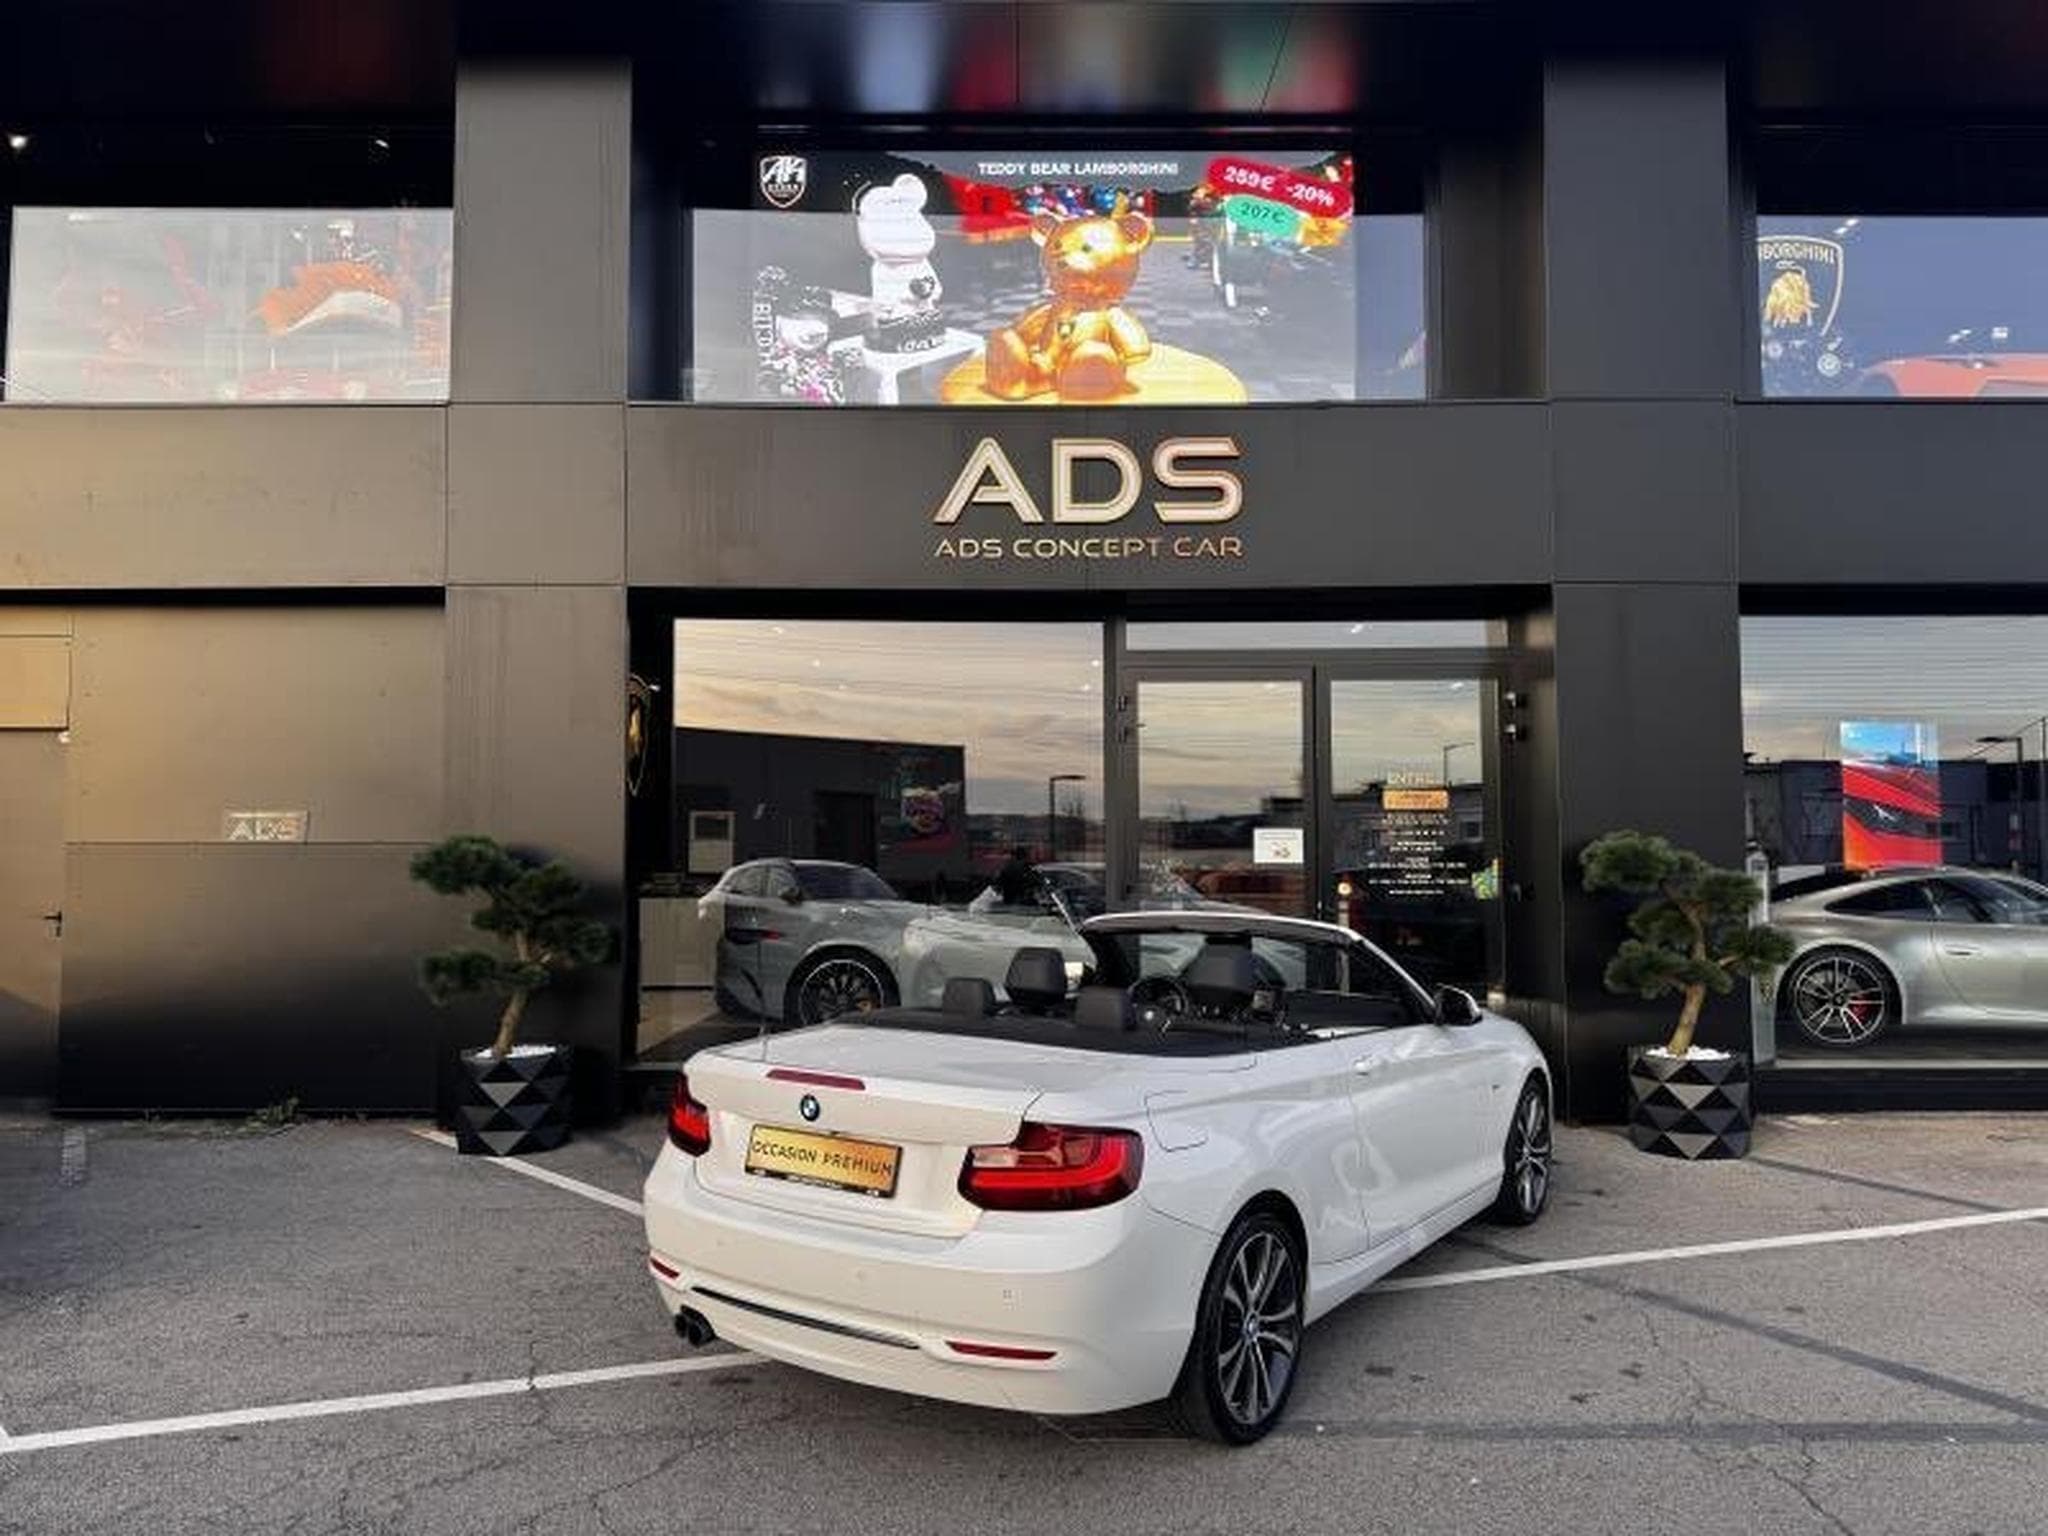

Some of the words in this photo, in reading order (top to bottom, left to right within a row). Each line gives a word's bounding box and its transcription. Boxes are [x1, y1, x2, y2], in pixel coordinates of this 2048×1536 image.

[977, 162, 1026, 175] TEDDY
[1030, 162, 1072, 175] BEAR
[1285, 183, 1335, 206] -20%
[933, 436, 1243, 524] ADS
[934, 538, 1002, 558] ADS
[1012, 538, 1159, 558] CONCEPT
[1172, 537, 1243, 557] CAR
[753, 1141, 817, 1163] OCCASION
[821, 1152, 892, 1175] PREMIUM
